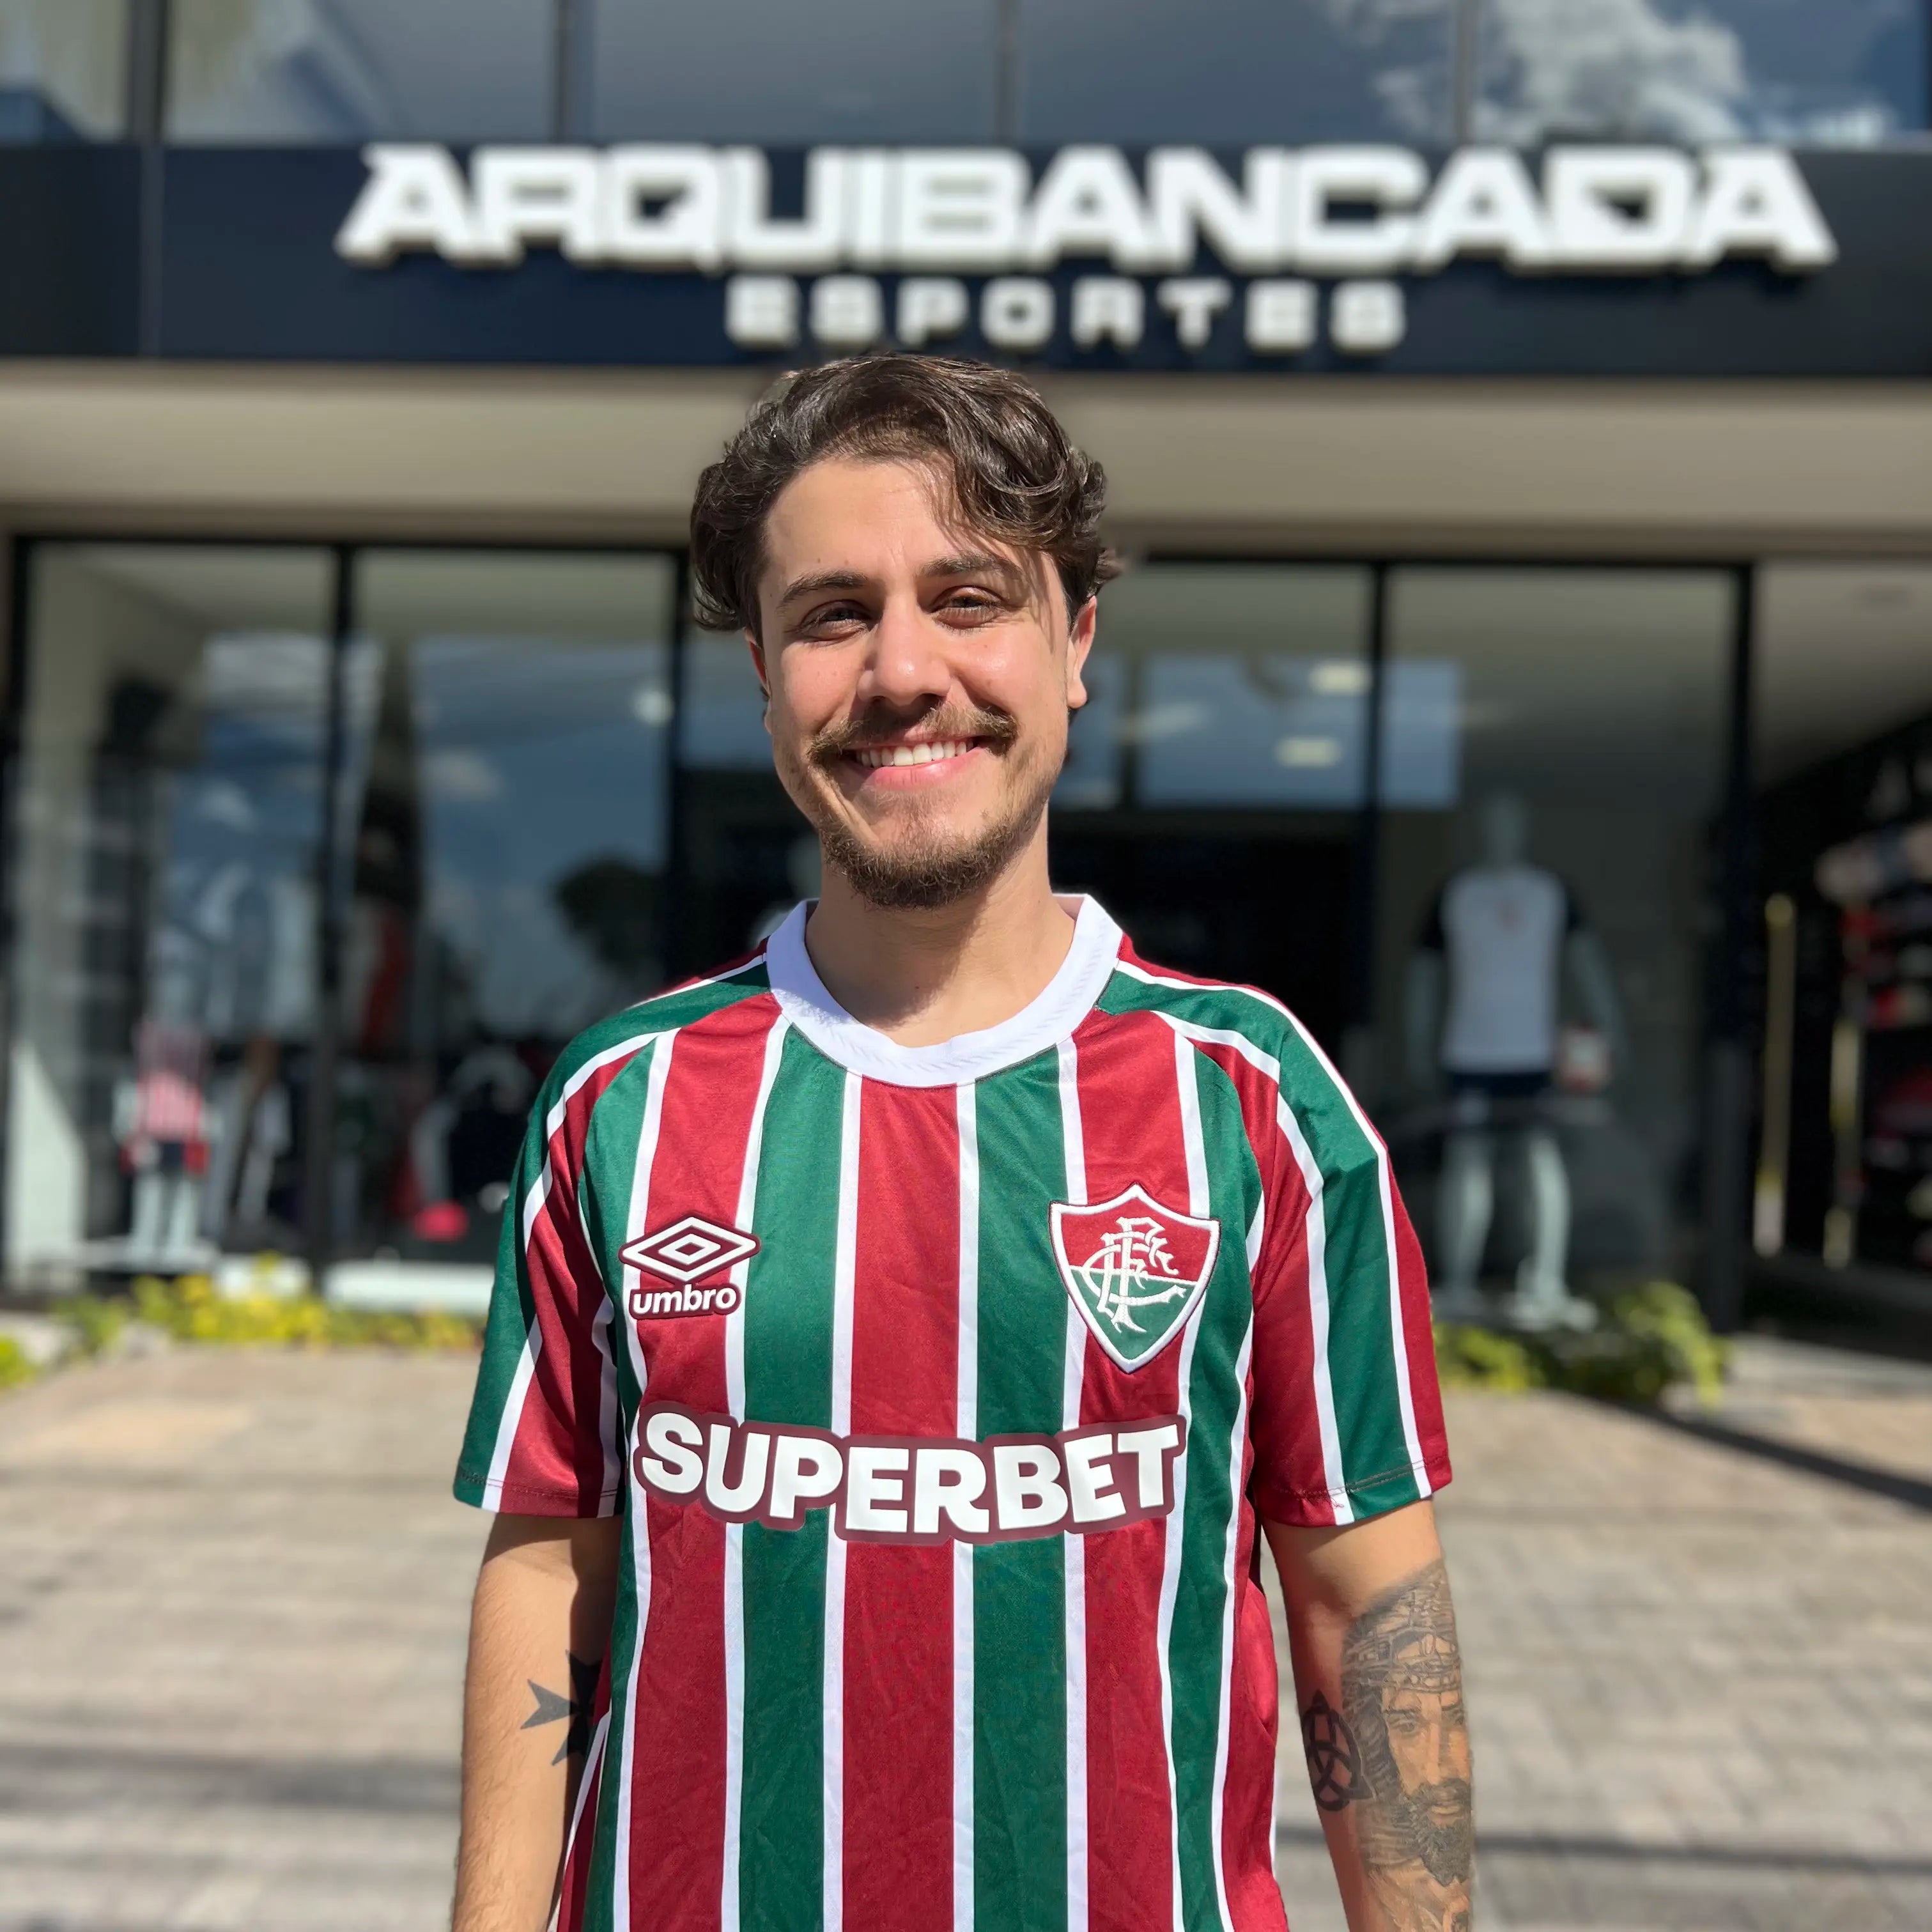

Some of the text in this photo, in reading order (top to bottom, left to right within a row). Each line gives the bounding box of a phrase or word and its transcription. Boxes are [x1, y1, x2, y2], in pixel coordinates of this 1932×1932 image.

[336, 144, 1836, 270] ARQUIBANCADA
[726, 275, 1405, 350] ESPORTES
[633, 1283, 738, 1314] umbro
[642, 1412, 1180, 1533] SUPERBET
